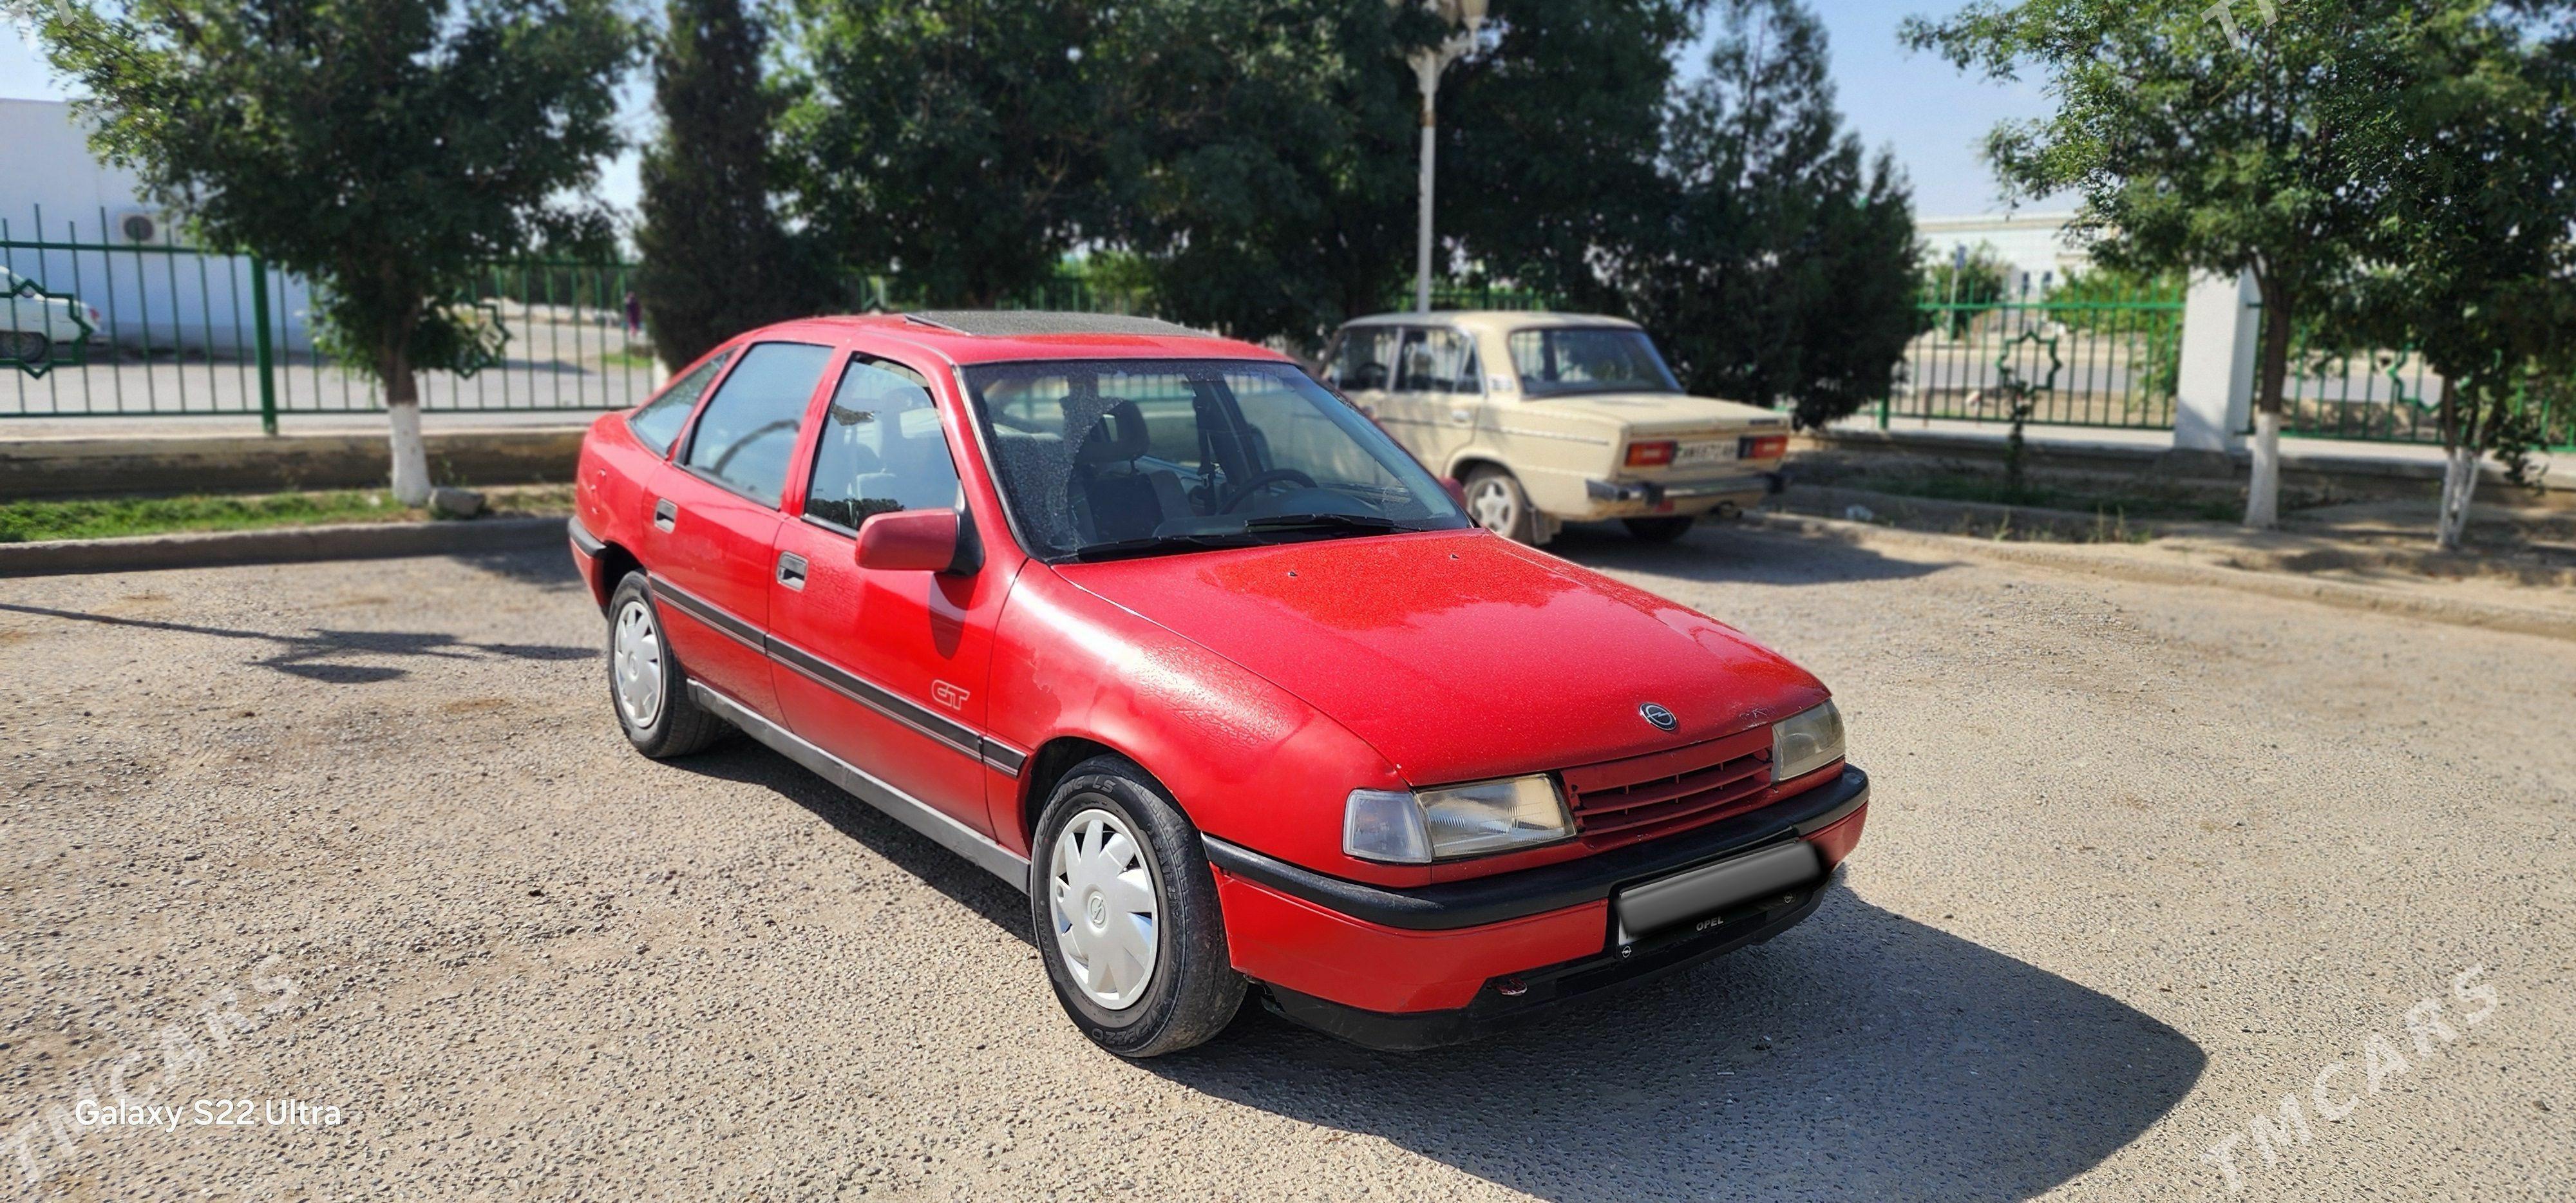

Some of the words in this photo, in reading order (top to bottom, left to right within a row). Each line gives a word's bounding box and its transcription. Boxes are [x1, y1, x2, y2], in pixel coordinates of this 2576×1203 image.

[931, 679, 971, 710] GT
[1092, 775, 1116, 793] LS
[1696, 916, 1724, 931] OPEL
